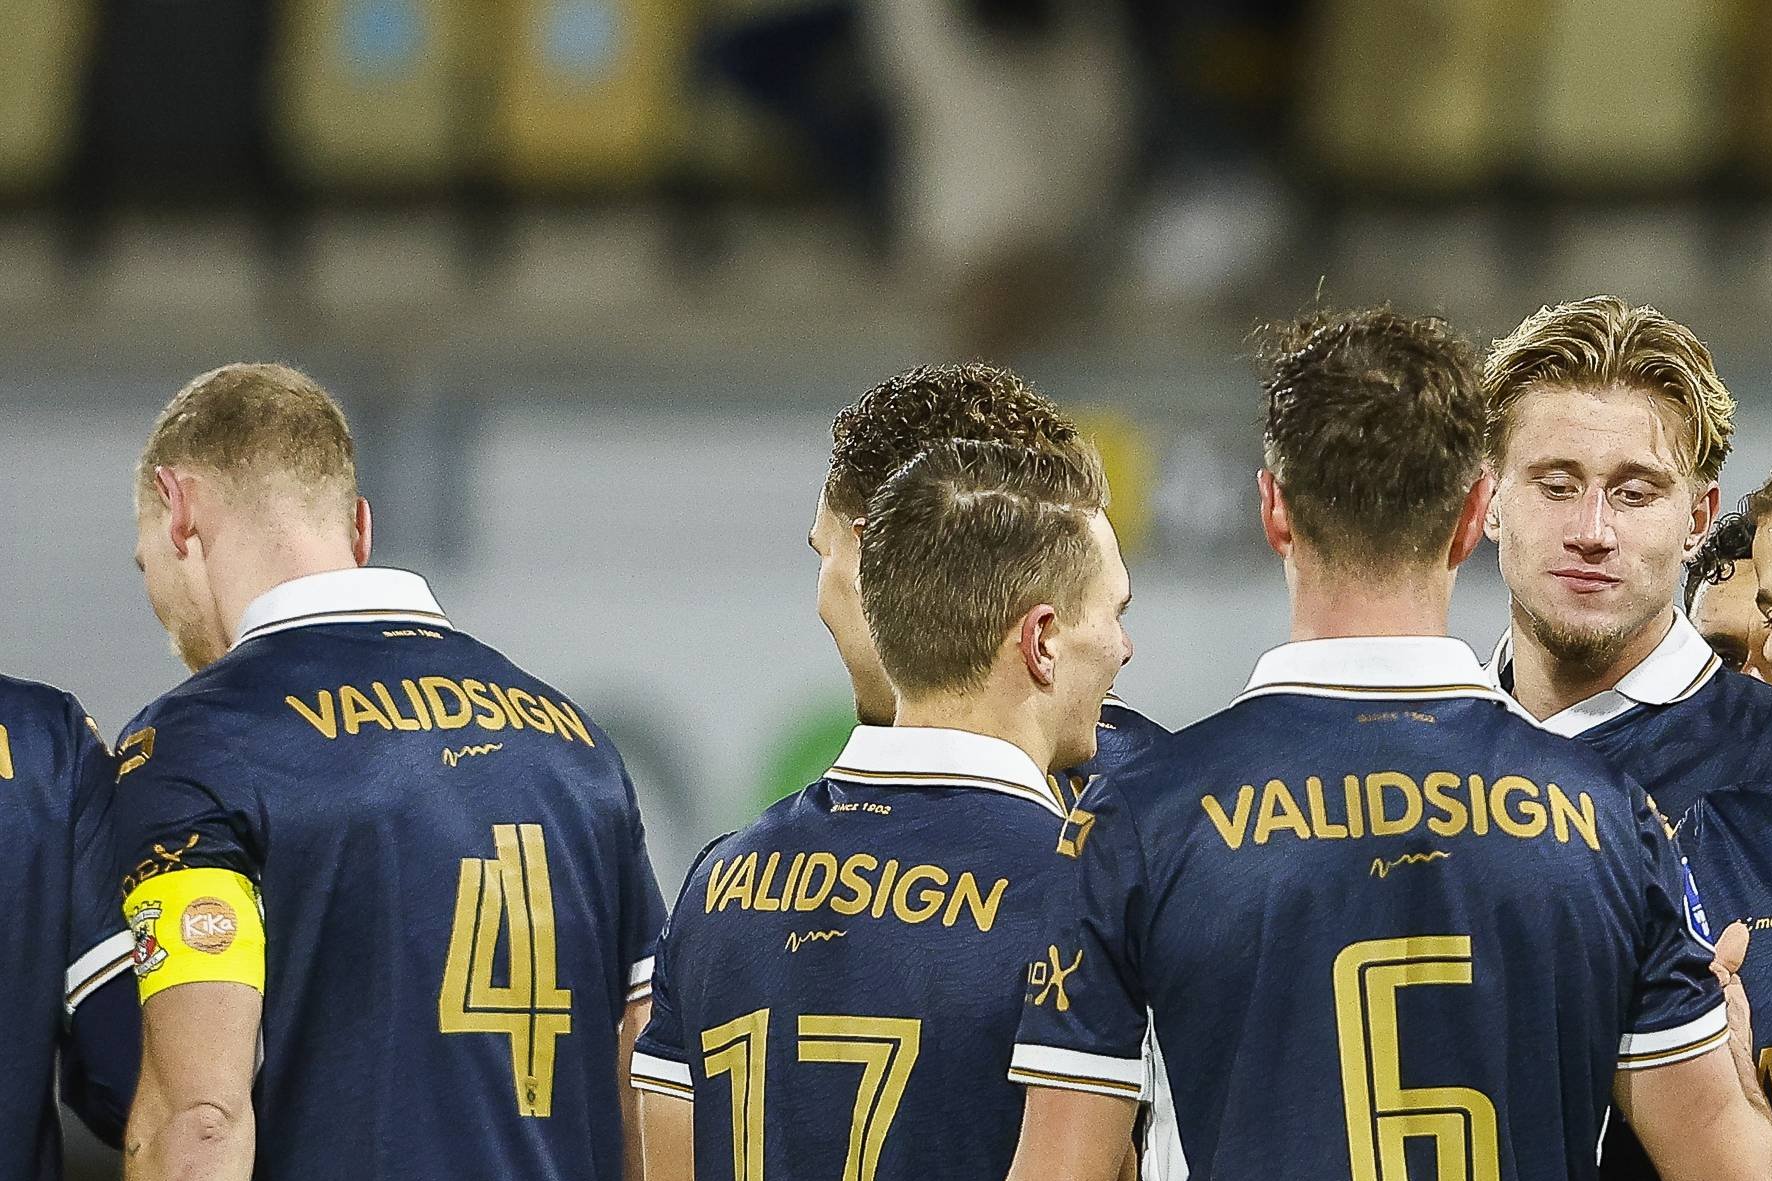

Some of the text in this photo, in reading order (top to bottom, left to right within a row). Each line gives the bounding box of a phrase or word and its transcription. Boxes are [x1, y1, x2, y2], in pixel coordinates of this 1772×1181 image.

[284, 676, 596, 748] VALIDSIGN
[1201, 771, 1601, 852] VALIDSIGN
[705, 851, 1009, 932] VALIDSIGN
[439, 823, 572, 1118] 4
